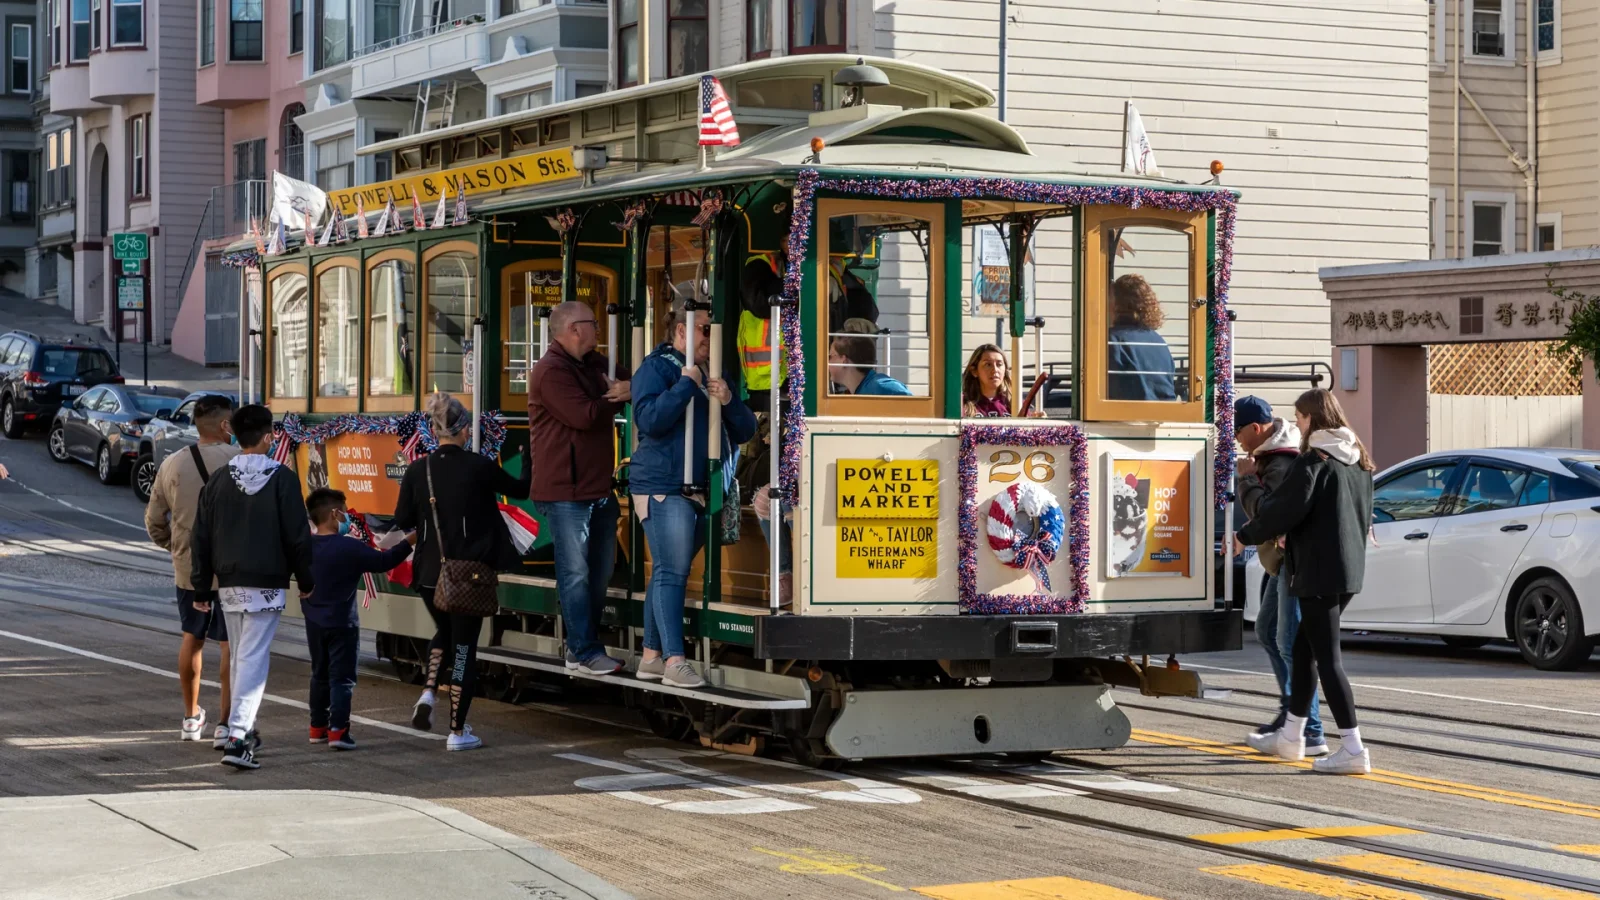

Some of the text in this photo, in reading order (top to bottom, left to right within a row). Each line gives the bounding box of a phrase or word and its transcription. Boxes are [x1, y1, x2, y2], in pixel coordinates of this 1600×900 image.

[337, 156, 571, 211] POWELL & MASON Sts.
[988, 267, 1009, 275] PRIVA
[985, 274, 1009, 282] PROPE
[529, 285, 542, 295] ARE
[576, 287, 591, 296] WAY
[337, 446, 372, 460] HOP ON TO
[337, 462, 378, 477] GHIRARDELLI
[989, 449, 1056, 483] 26
[844, 467, 934, 482] POWELL
[347, 479, 373, 493] SQUARE
[868, 483, 912, 494] AND
[1154, 487, 1177, 499] HOP
[842, 494, 935, 508] MARKET
[1153, 500, 1170, 511] ON
[1153, 513, 1169, 524] TO
[841, 526, 934, 543] BAY AND TAYLOR
[849, 546, 925, 557] FISHERMANS
[867, 558, 907, 570] WHARF
[718, 621, 754, 634] TWO STANDEES
[451, 643, 469, 682] PINK
